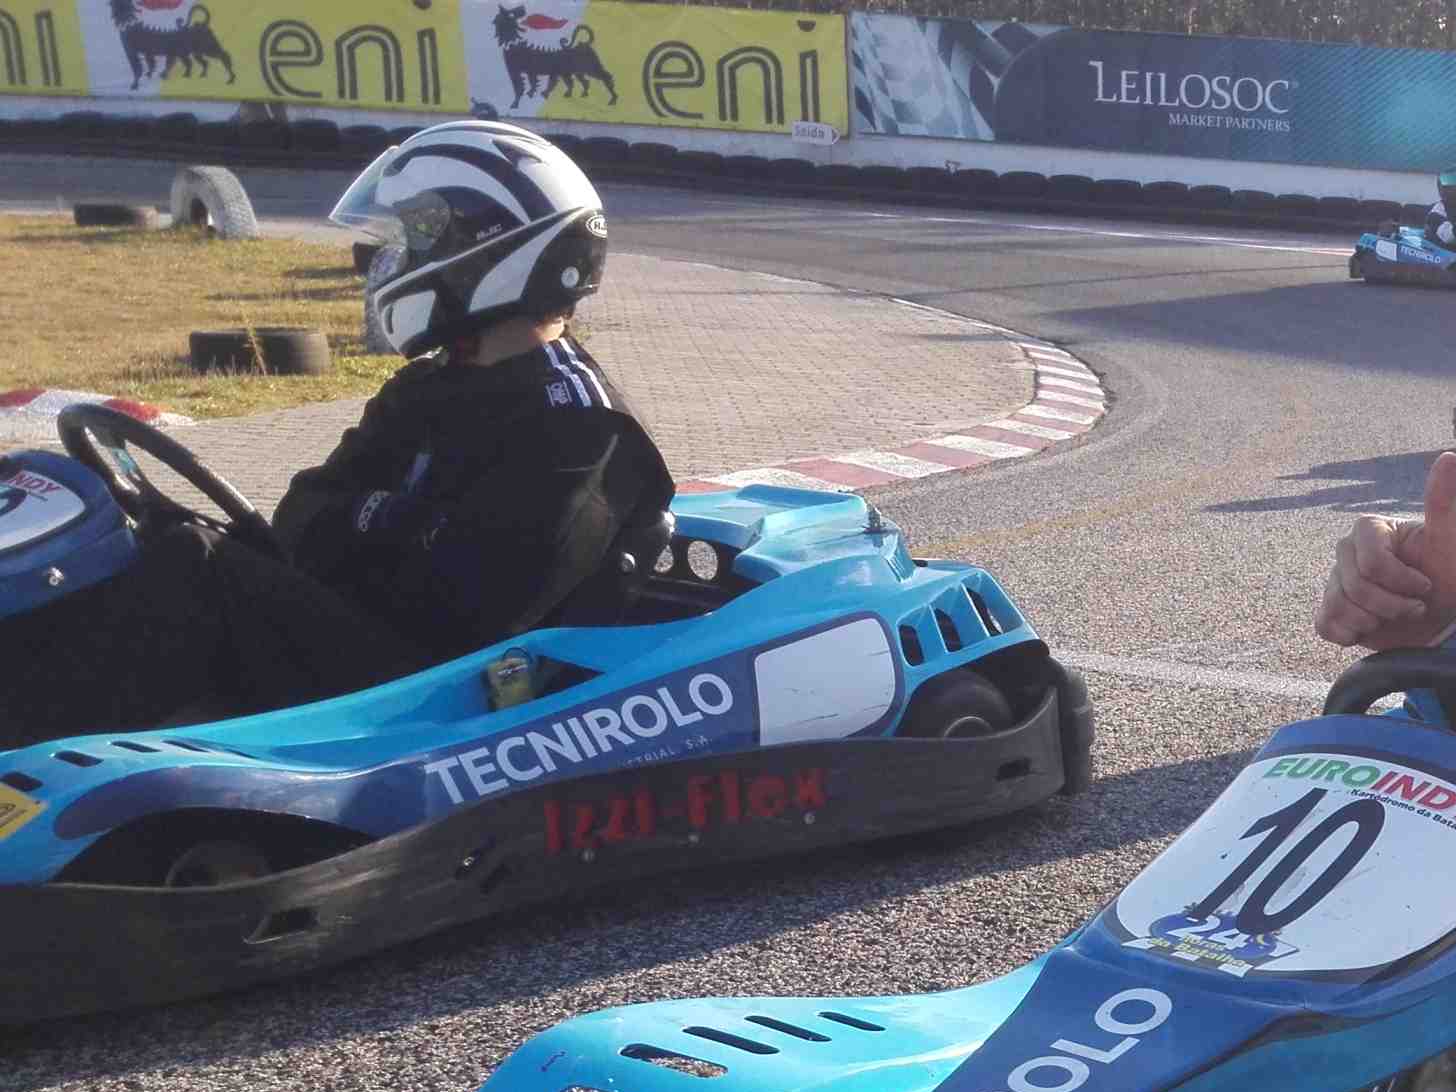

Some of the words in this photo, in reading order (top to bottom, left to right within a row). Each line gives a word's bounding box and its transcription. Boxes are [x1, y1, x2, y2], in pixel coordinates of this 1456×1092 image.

[259, 0, 440, 104] eni
[642, 20, 820, 125] eni
[1089, 60, 1290, 115] LEILOSOC
[1168, 113, 1224, 128] MARKET
[1225, 115, 1291, 132] PARTNERS
[424, 672, 734, 805] TECNIROLO
[1188, 786, 1387, 934] 10
